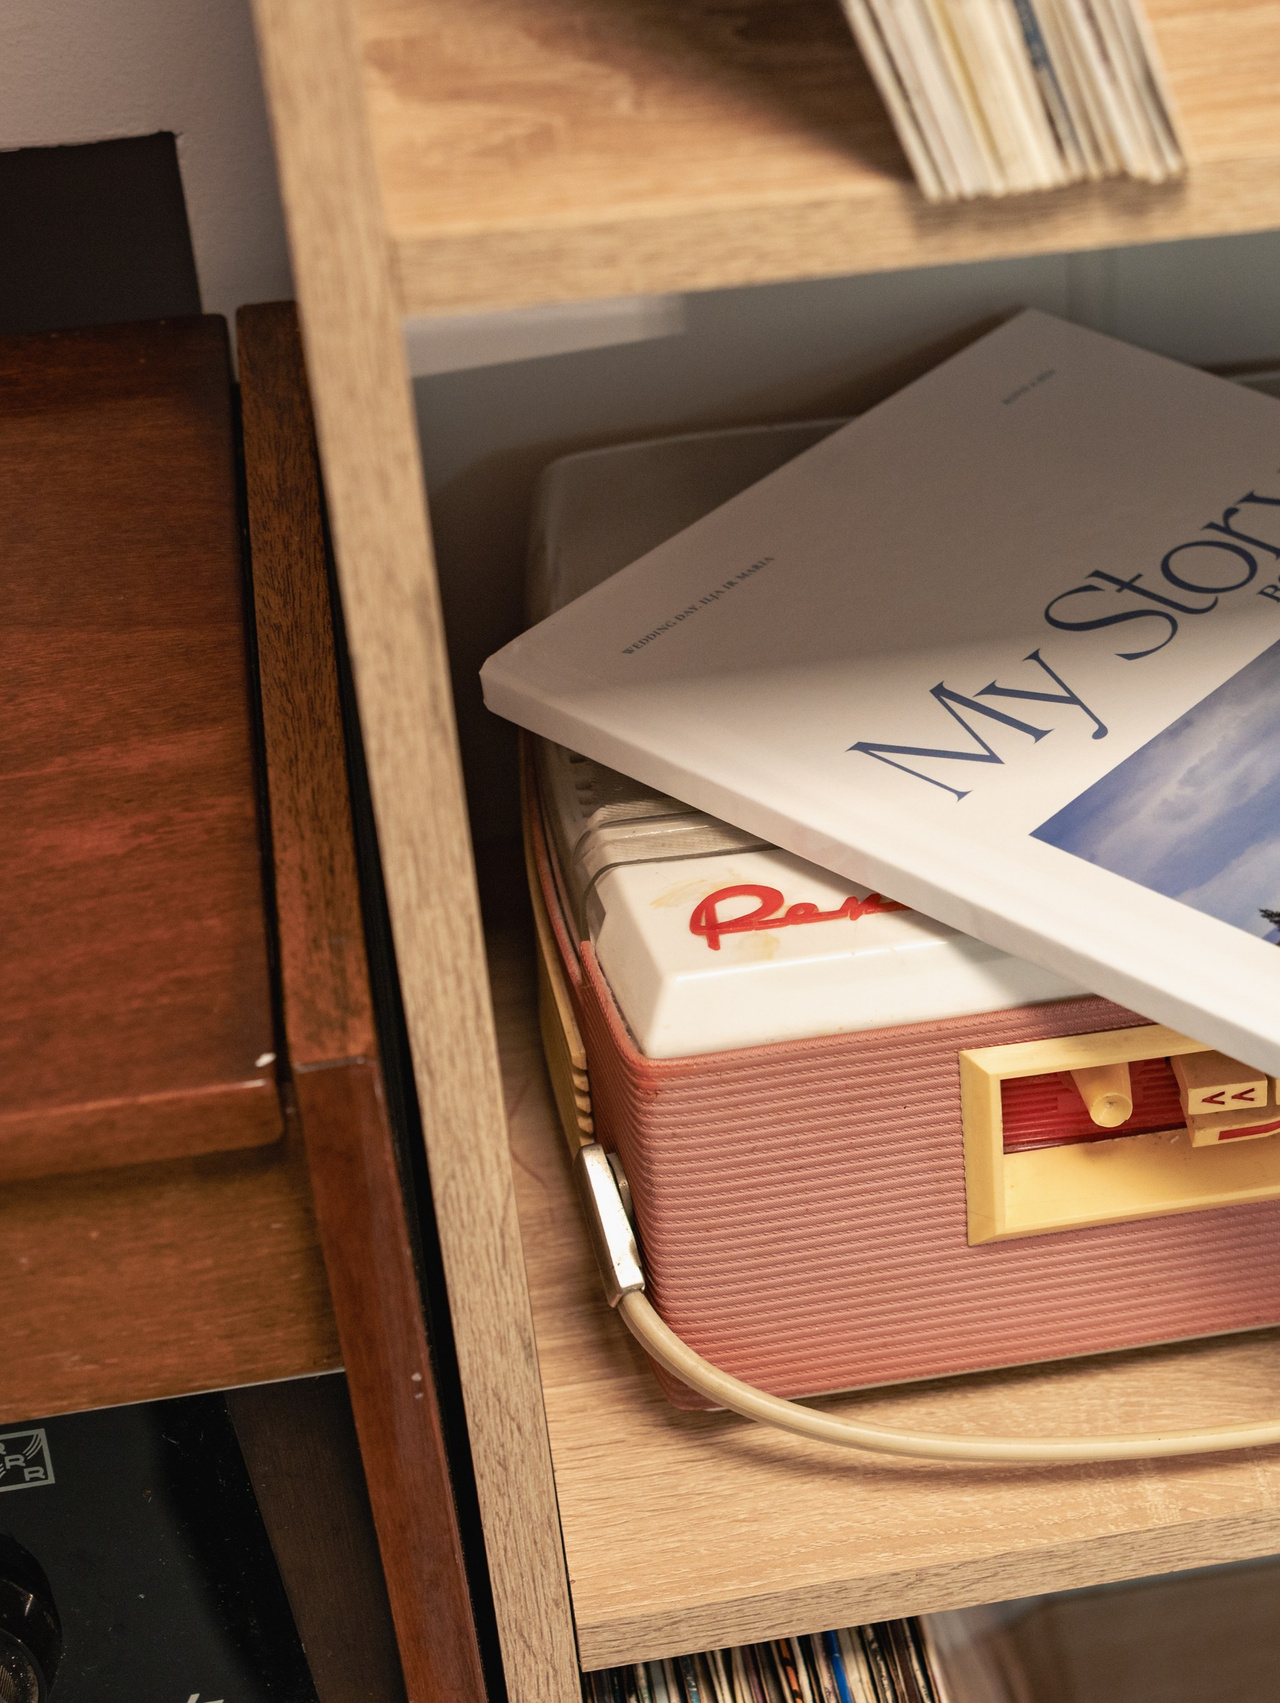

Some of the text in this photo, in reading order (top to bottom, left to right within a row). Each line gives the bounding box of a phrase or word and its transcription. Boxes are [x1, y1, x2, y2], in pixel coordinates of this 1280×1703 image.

[621, 621, 677, 655] WEDDING
[735, 556, 775, 580] MARIA
[845, 647, 1109, 802] My
